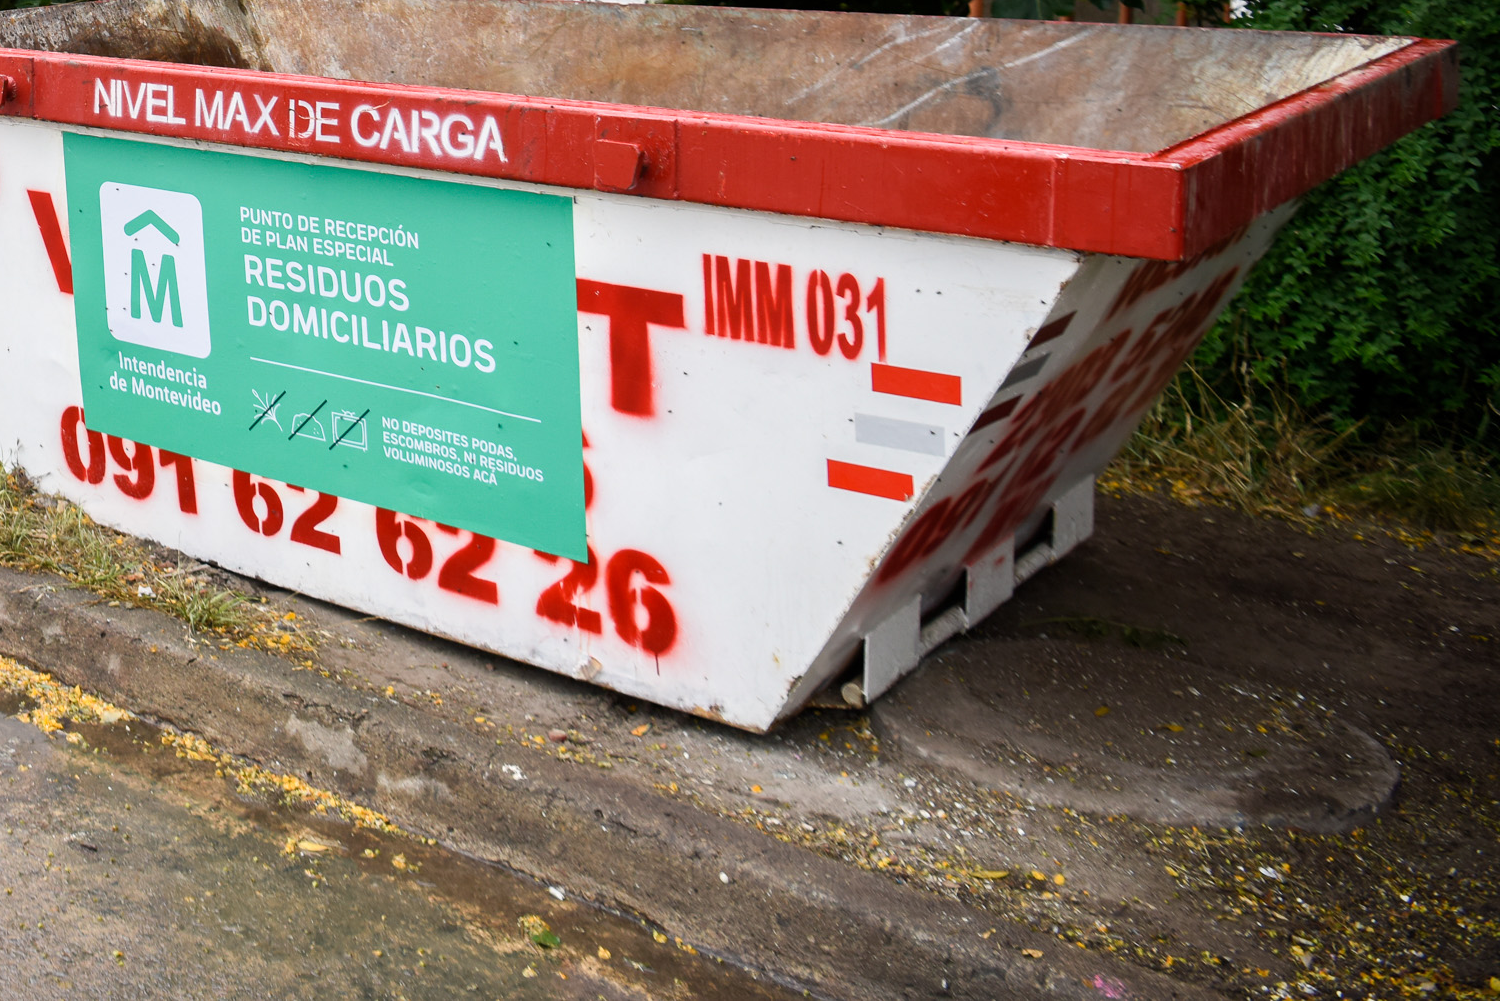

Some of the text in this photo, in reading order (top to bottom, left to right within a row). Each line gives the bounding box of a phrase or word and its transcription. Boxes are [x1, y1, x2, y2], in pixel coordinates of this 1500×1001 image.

[92, 78, 509, 163] NIVEL MAX DE CARGA
[240, 206, 419, 249] PUNTO DE RECEPCIÓN
[241, 227, 394, 266] DE PLAN ESPECIAL
[244, 254, 410, 312] RESIDUOS
[702, 254, 796, 349] IMM
[806, 269, 887, 363] 031
[247, 295, 496, 374] DOMICILIARIOS
[109, 370, 222, 415] de Montevideo
[118, 351, 207, 389] Intendencia
[382, 416, 518, 462] NO DEPOSITES PODAS,
[382, 431, 544, 482] ESCOMBROS, NI RESIDUOS
[383, 445, 498, 485] VOLUMINOSOS ACÁ
[533, 547, 679, 656] 26
